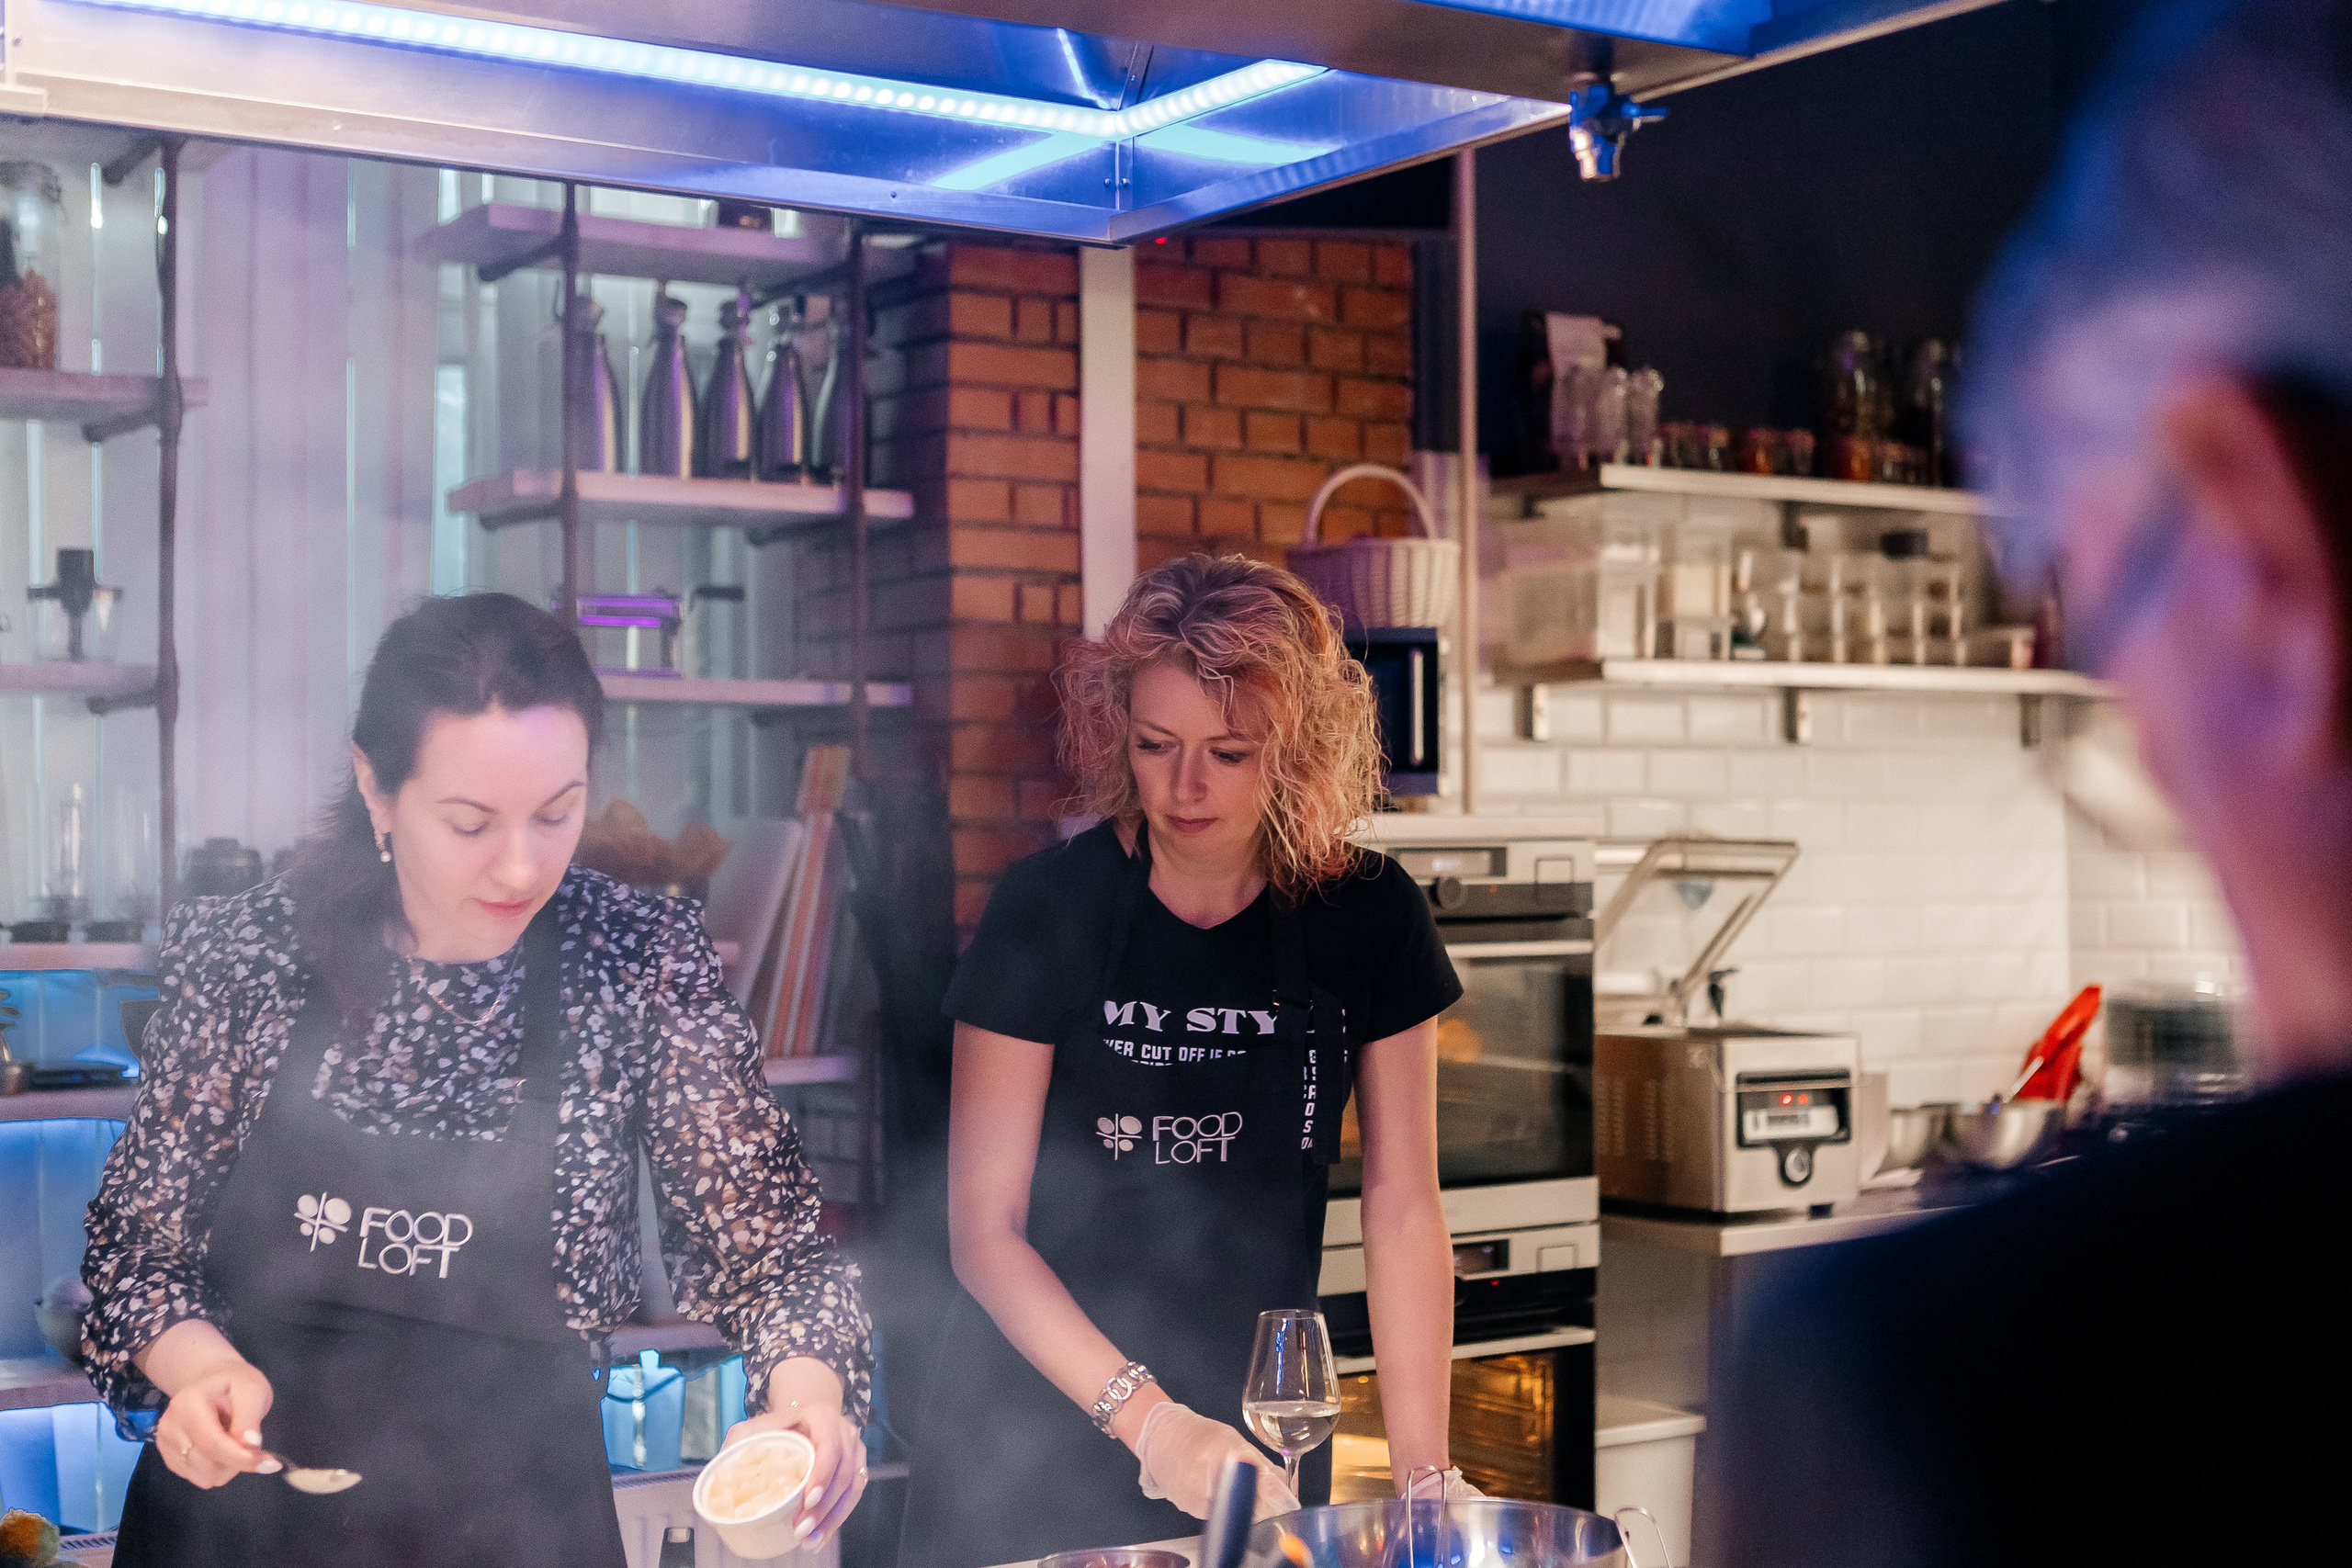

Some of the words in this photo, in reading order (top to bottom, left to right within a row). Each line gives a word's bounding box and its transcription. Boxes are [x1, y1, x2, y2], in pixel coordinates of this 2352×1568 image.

[1103, 1000, 1171, 1032] MY
[1140, 1043, 1172, 1061] CUT
[1179, 1046, 1205, 1063] OFF
[1152, 1111, 1243, 1141] FOOD
[1155, 1135, 1236, 1165] LOFT
[358, 1206, 474, 1247] FOOD
[357, 1237, 460, 1279] LOFT
